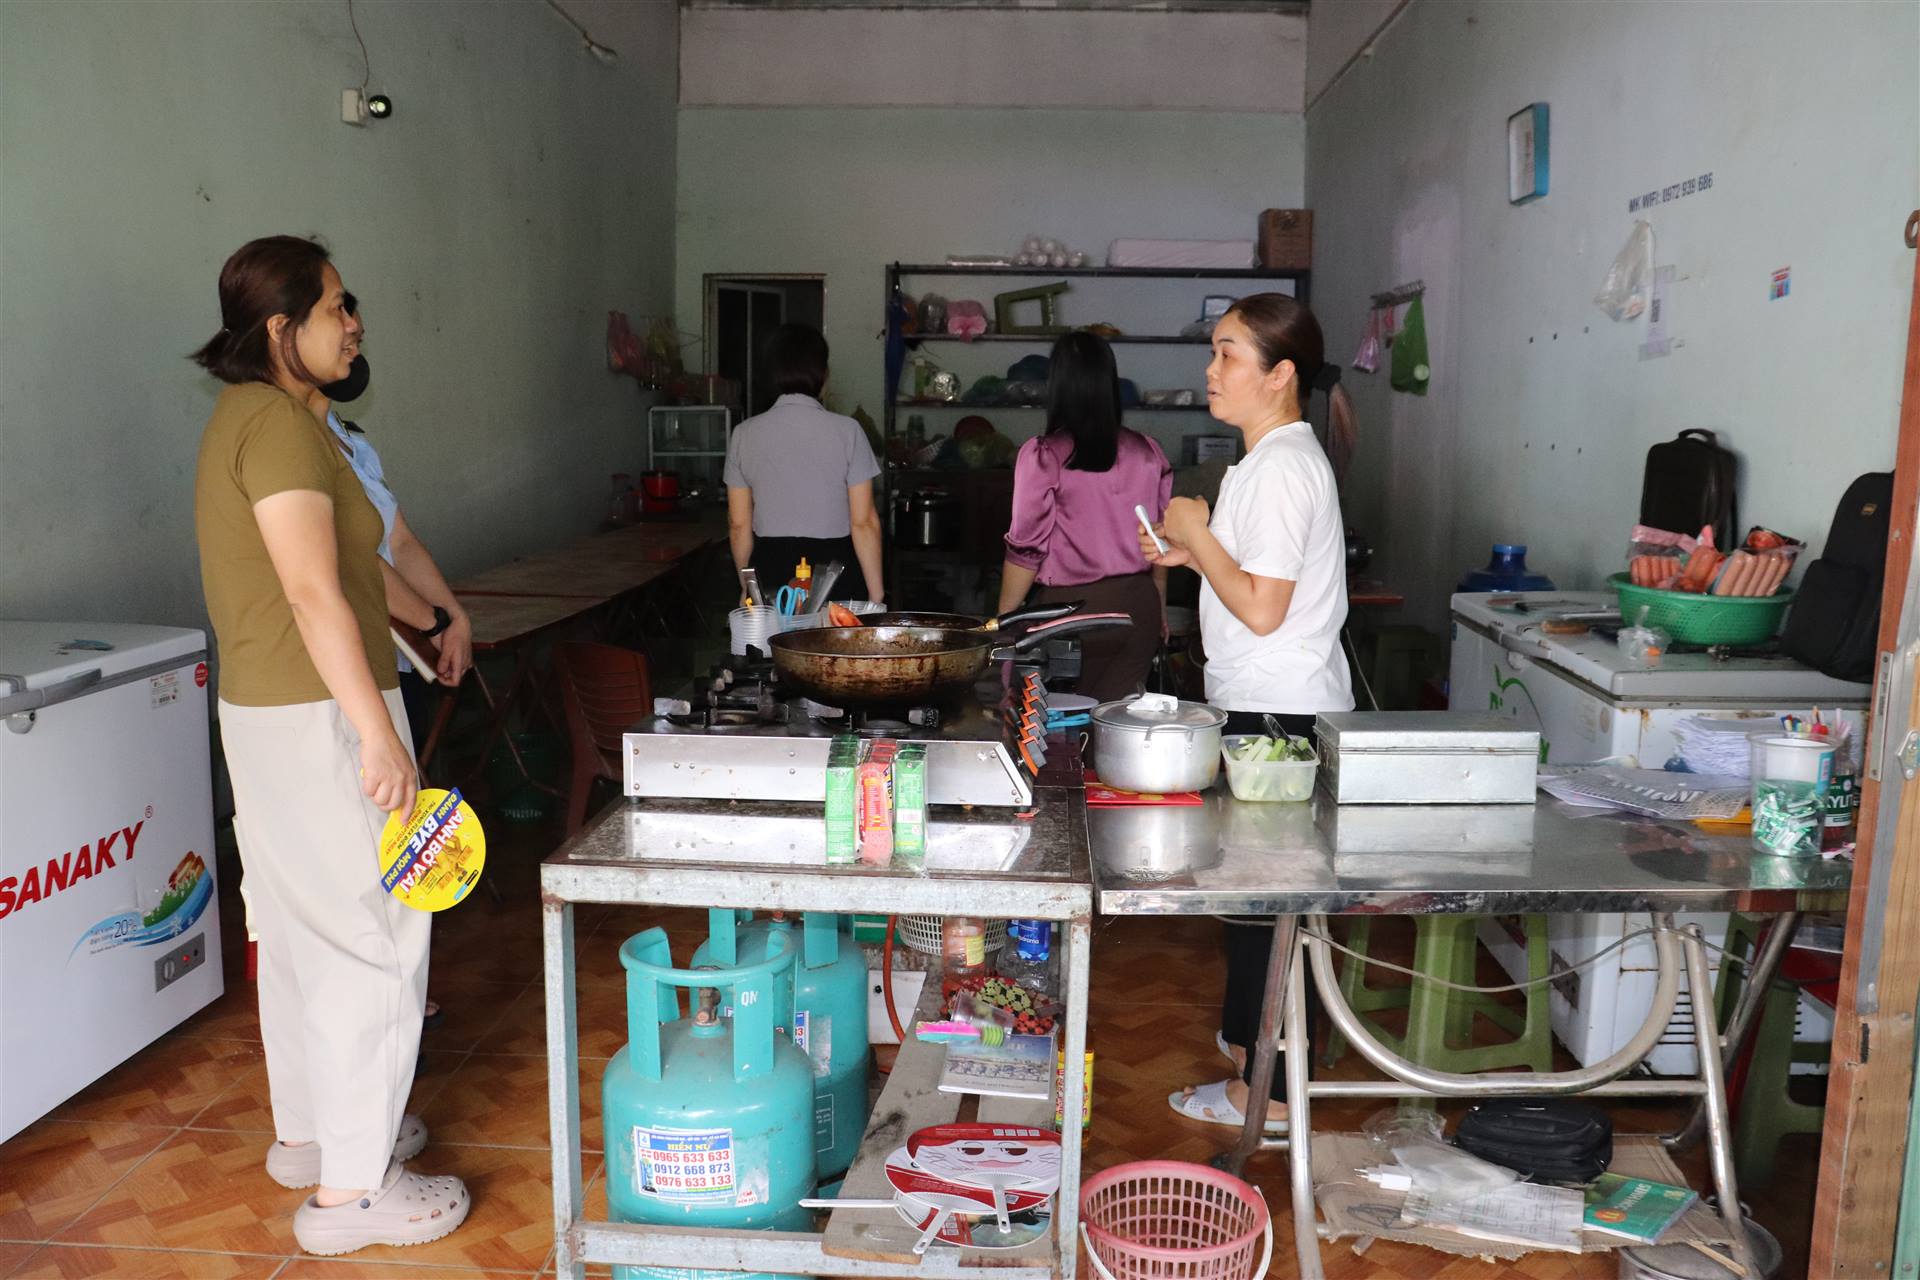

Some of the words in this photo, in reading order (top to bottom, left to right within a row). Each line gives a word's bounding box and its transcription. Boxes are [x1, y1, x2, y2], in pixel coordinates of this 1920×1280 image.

[407, 813, 439, 854] BYE
[435, 809, 465, 846] ANH
[0, 820, 145, 910] SANAKY
[653, 1151, 680, 1162] 0965
[683, 1152, 704, 1163] 633
[708, 1150, 730, 1161] 633
[654, 1163, 681, 1175] 0912
[684, 1165, 705, 1175] 668
[709, 1162, 730, 1174] 873
[655, 1175, 682, 1187] 0976
[685, 1177, 706, 1187] 633
[711, 1174, 731, 1186] 133
